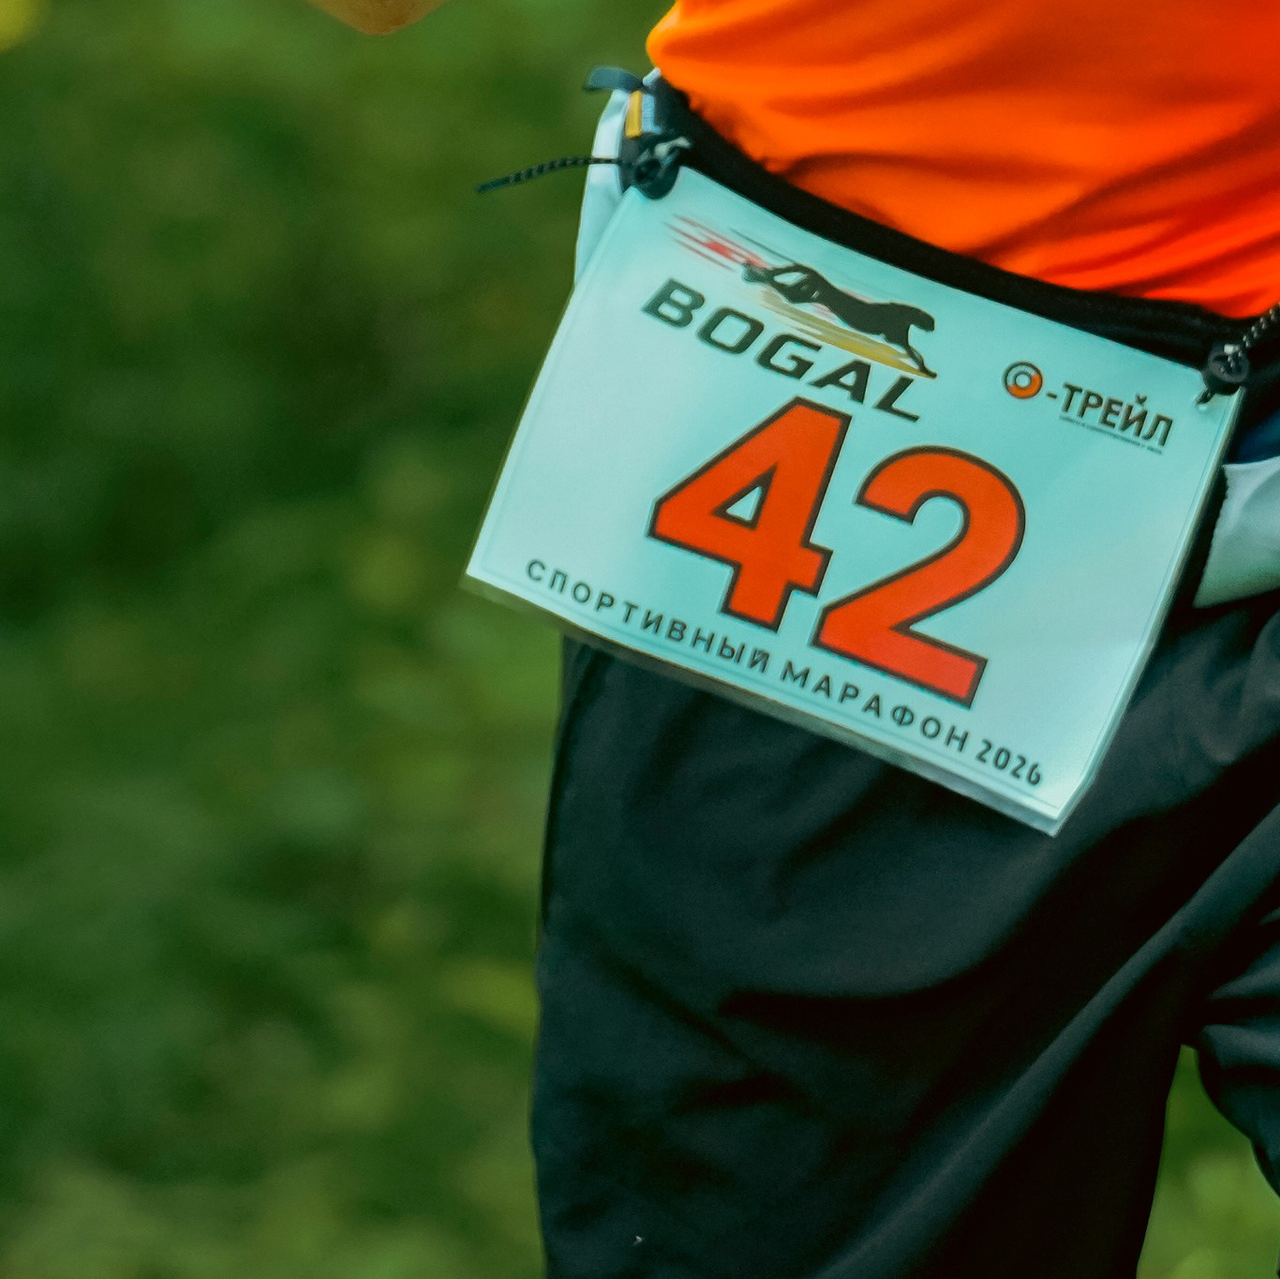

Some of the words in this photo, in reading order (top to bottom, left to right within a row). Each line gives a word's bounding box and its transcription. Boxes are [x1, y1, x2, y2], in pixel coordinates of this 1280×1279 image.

[640, 277, 921, 424] BOGAL
[645, 394, 1027, 710] 42
[526, 558, 771, 675] СПОРТИВНЫЙ
[779, 660, 970, 754] МАРАФОН
[975, 738, 1043, 787] 2026
